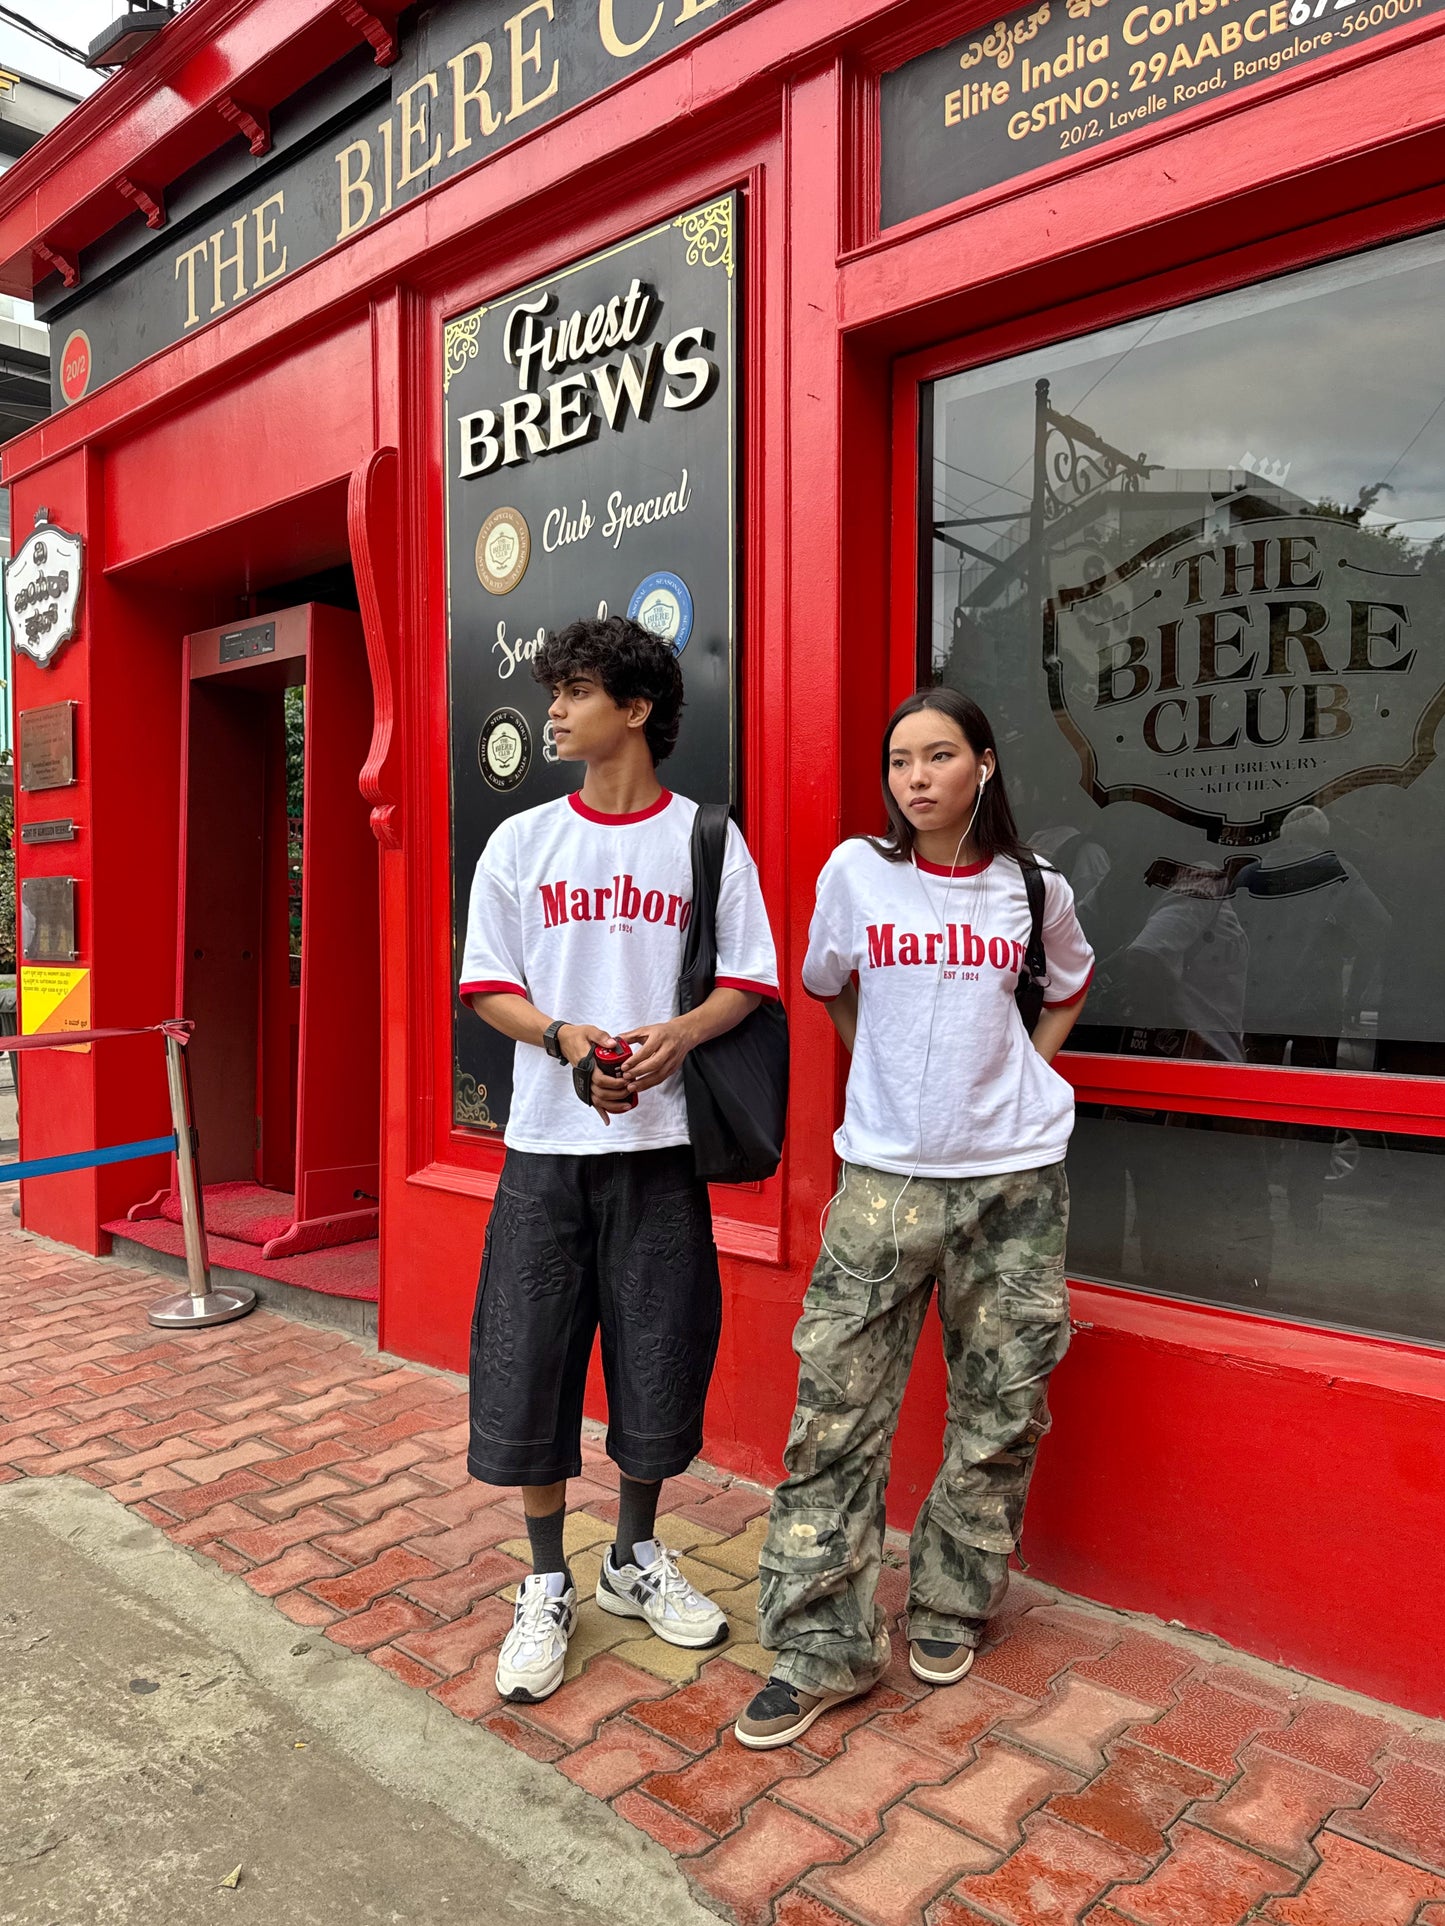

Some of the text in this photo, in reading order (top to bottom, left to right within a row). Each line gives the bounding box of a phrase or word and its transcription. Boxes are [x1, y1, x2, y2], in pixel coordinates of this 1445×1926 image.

[944, 80, 1011, 127] Elite
[1021, 35, 1110, 93] India
[1007, 77, 1120, 140] GSTNO:
[1059, 119, 1104, 149] 20/2,
[1109, 94, 1168, 129] Lavelle
[1173, 68, 1228, 104] Road,
[175, 190, 287, 329] THE
[335, 0, 559, 242] BIERE
[66, 355, 86, 383] 20/2
[503, 278, 651, 390] Finest
[457, 327, 711, 479] BREWS
[542, 468, 692, 552] Club Special
[1172, 535, 1325, 609] THE
[1094, 600, 1417, 710] BIERE
[1142, 682, 1354, 756] CLUB
[1173, 757, 1319, 779] CRAFT BREWERY
[1207, 778, 1283, 794] KITCHEN
[539, 874, 692, 933] Marlboro
[619, 923, 633, 934] 1924
[943, 971, 979, 982] EST 1924
